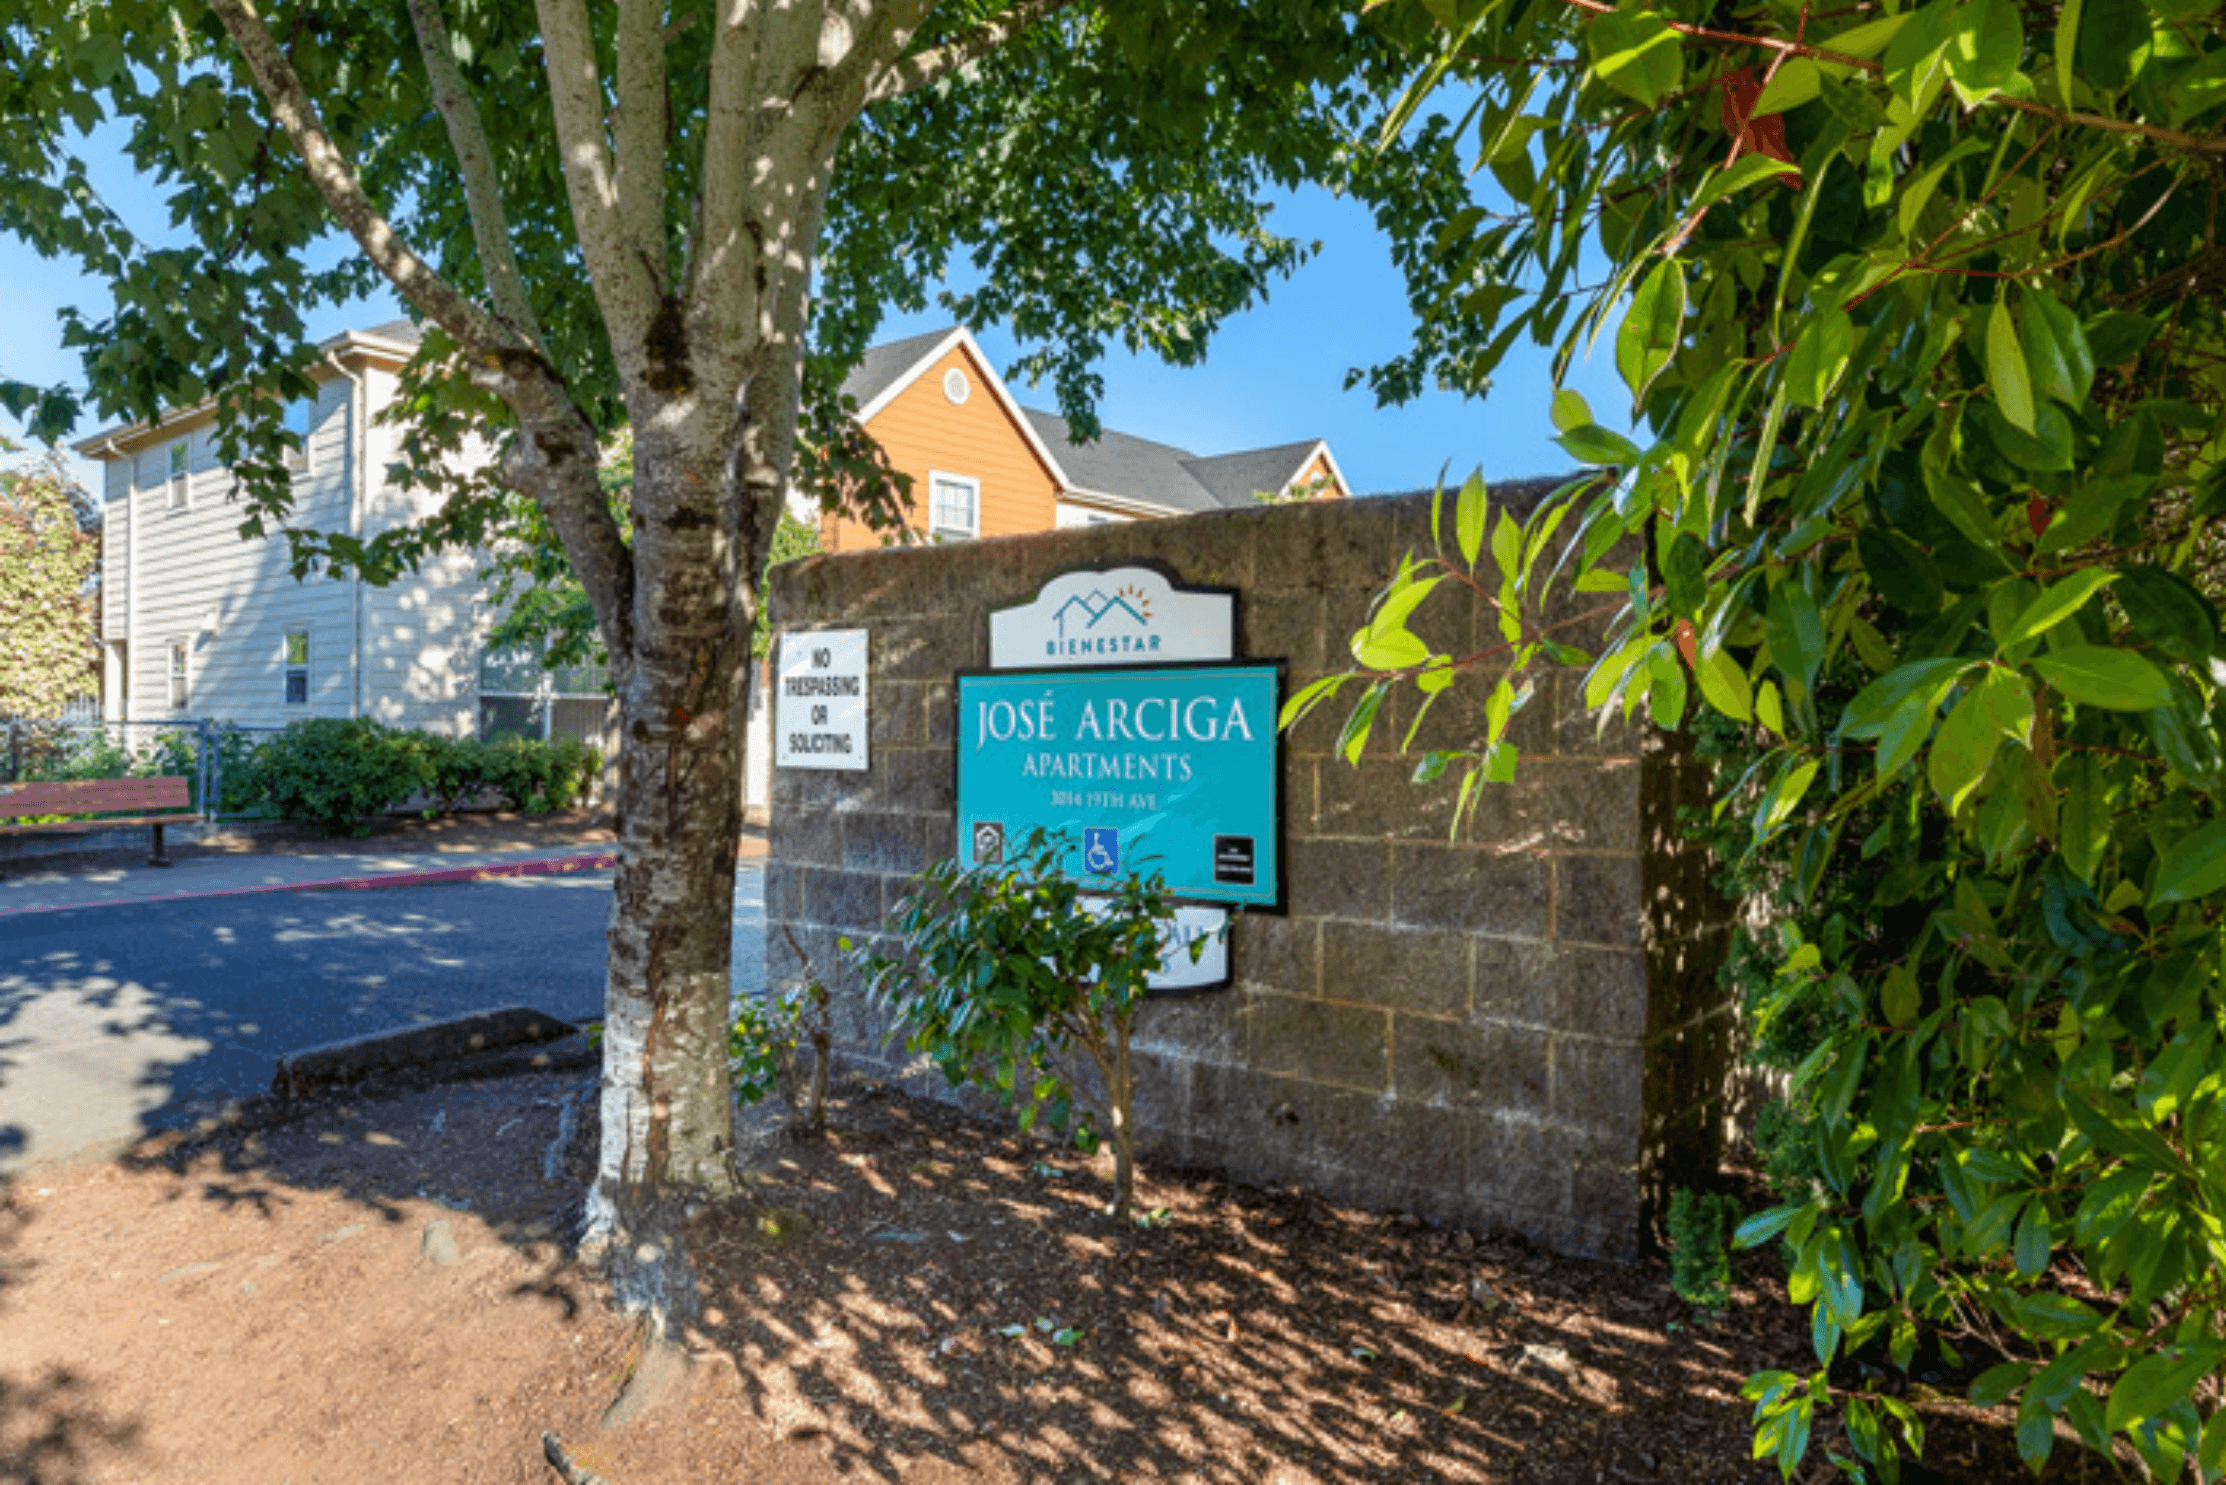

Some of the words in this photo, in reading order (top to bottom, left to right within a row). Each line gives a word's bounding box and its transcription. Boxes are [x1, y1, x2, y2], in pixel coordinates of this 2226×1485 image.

[1046, 635, 1161, 655] BIENESTAR
[812, 648, 831, 669] NO
[785, 676, 859, 696] TRESPASSING
[811, 704, 828, 725] OR
[976, 689, 1056, 751] JOSÉ
[1074, 696, 1255, 741] ARCIGA
[789, 733, 852, 754] SOLICITING
[1021, 752, 1194, 782] APARTMENTS
